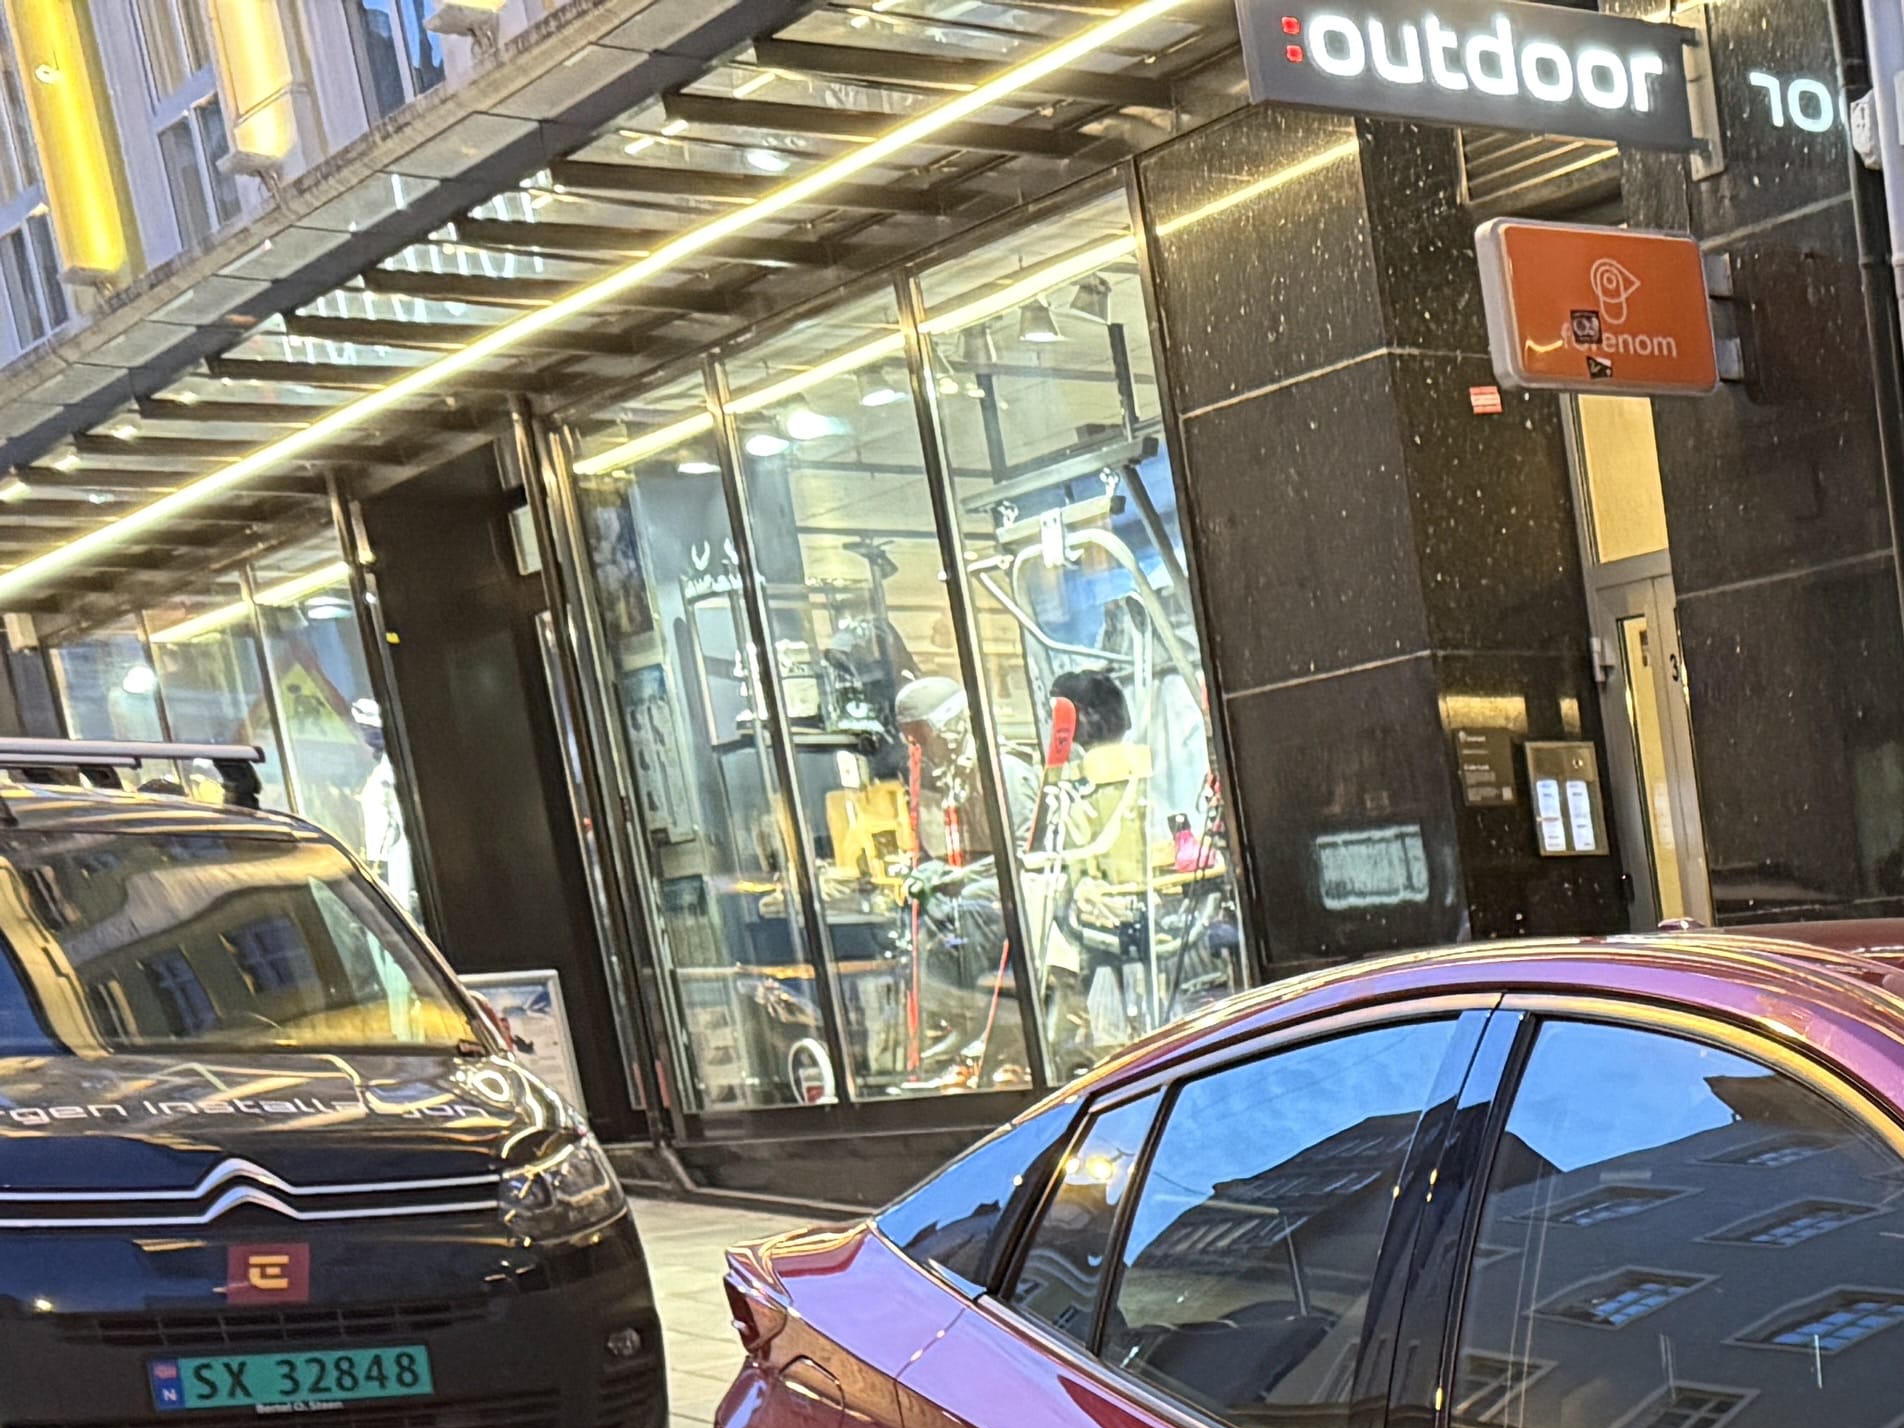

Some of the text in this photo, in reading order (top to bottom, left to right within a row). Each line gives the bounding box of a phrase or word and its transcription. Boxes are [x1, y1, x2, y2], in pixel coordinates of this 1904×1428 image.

[1560, 321, 1678, 358] fenom
[0, 1104, 129, 1126] gen
[192, 1351, 420, 1400] SX 32848
